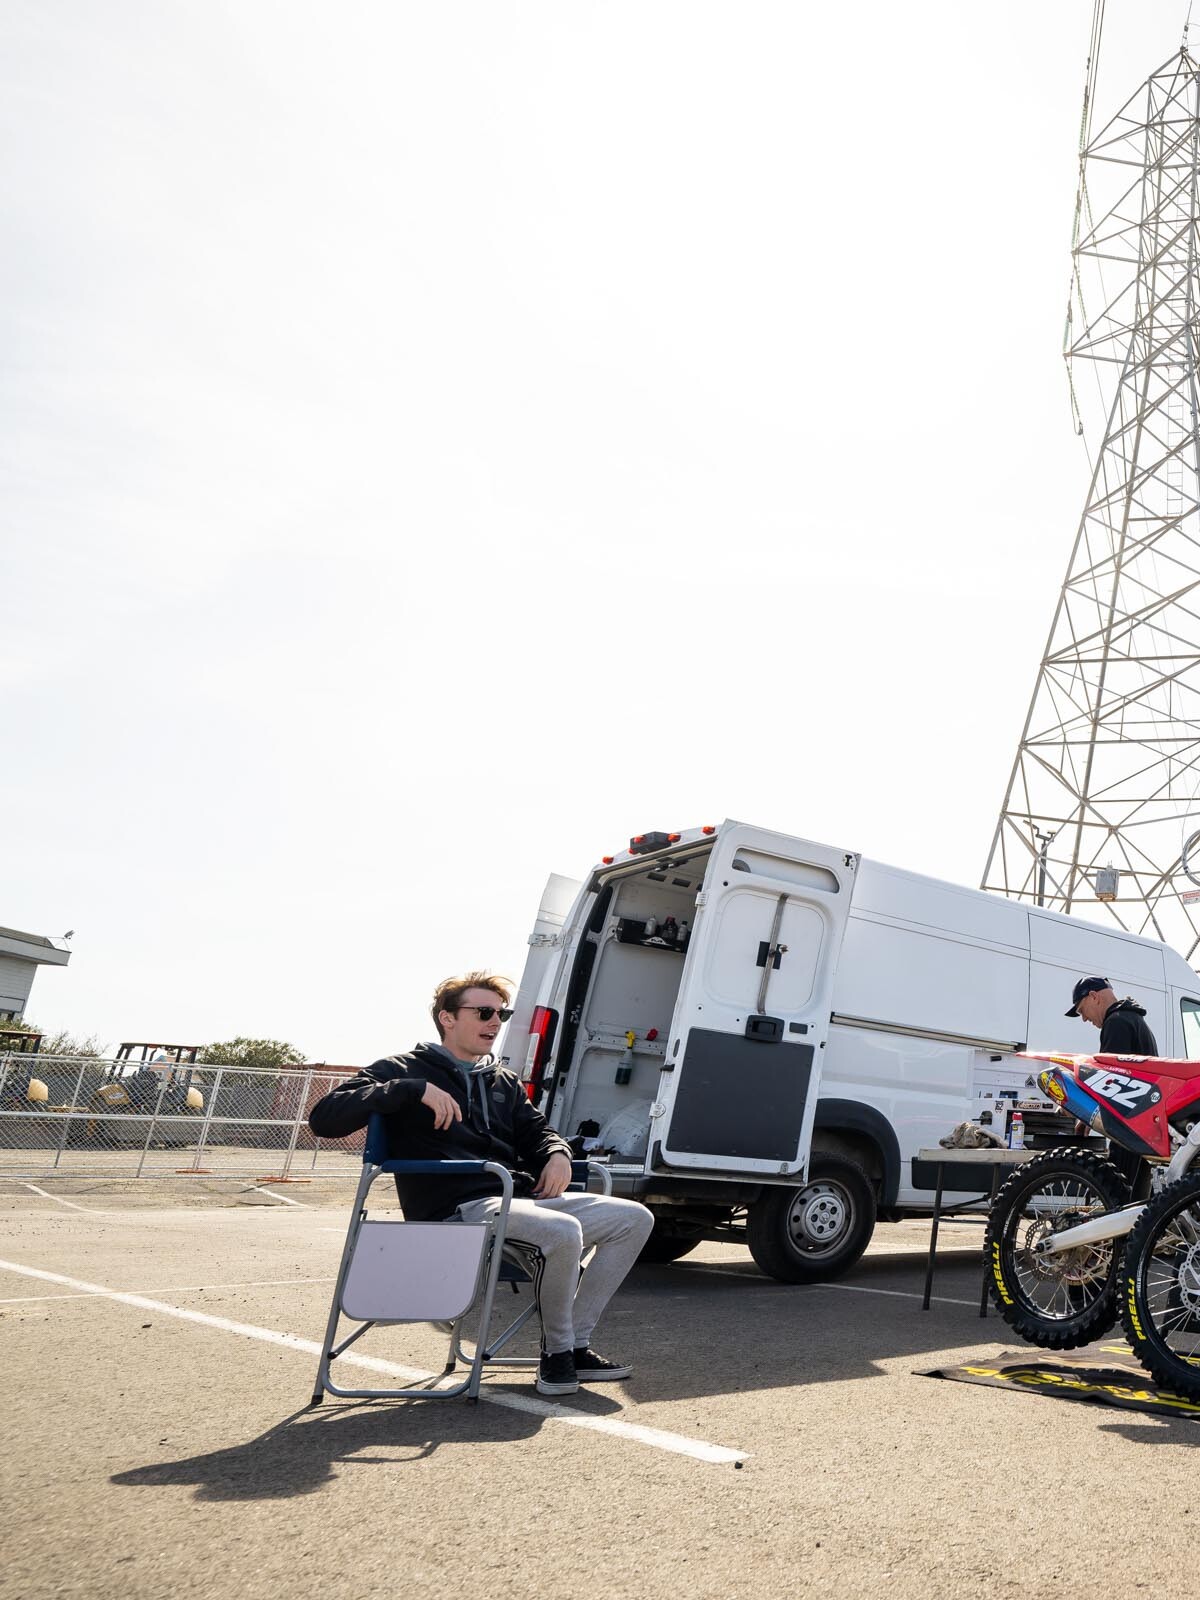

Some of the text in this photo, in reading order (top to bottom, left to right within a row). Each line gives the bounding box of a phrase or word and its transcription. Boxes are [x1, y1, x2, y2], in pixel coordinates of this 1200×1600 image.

[1083, 1069, 1151, 1109] 162
[992, 1242, 1014, 1305] PIRELLI
[1128, 1277, 1147, 1340] PIRELLI
